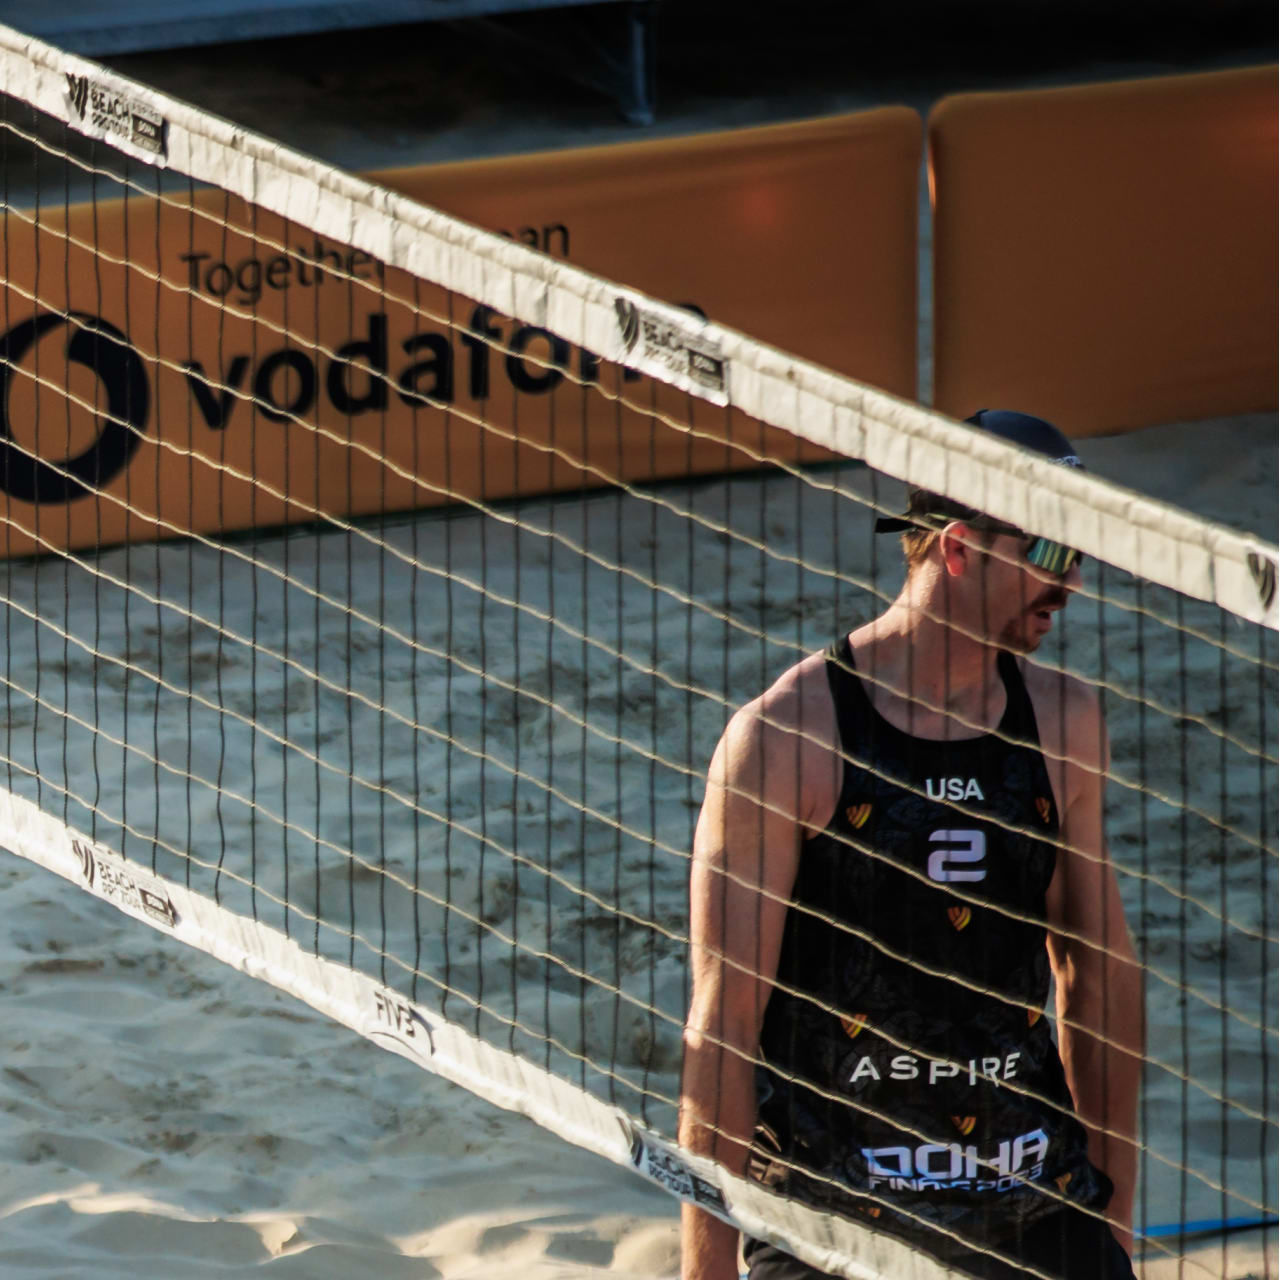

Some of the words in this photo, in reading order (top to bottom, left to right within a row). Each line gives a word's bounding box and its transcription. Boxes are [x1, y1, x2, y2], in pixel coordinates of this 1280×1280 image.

[183, 302, 708, 431] vodafo
[925, 776, 985, 801] USA
[928, 829, 987, 882] 2
[849, 1051, 1022, 1089] ASPIRE
[861, 1128, 1050, 1180] DOHA
